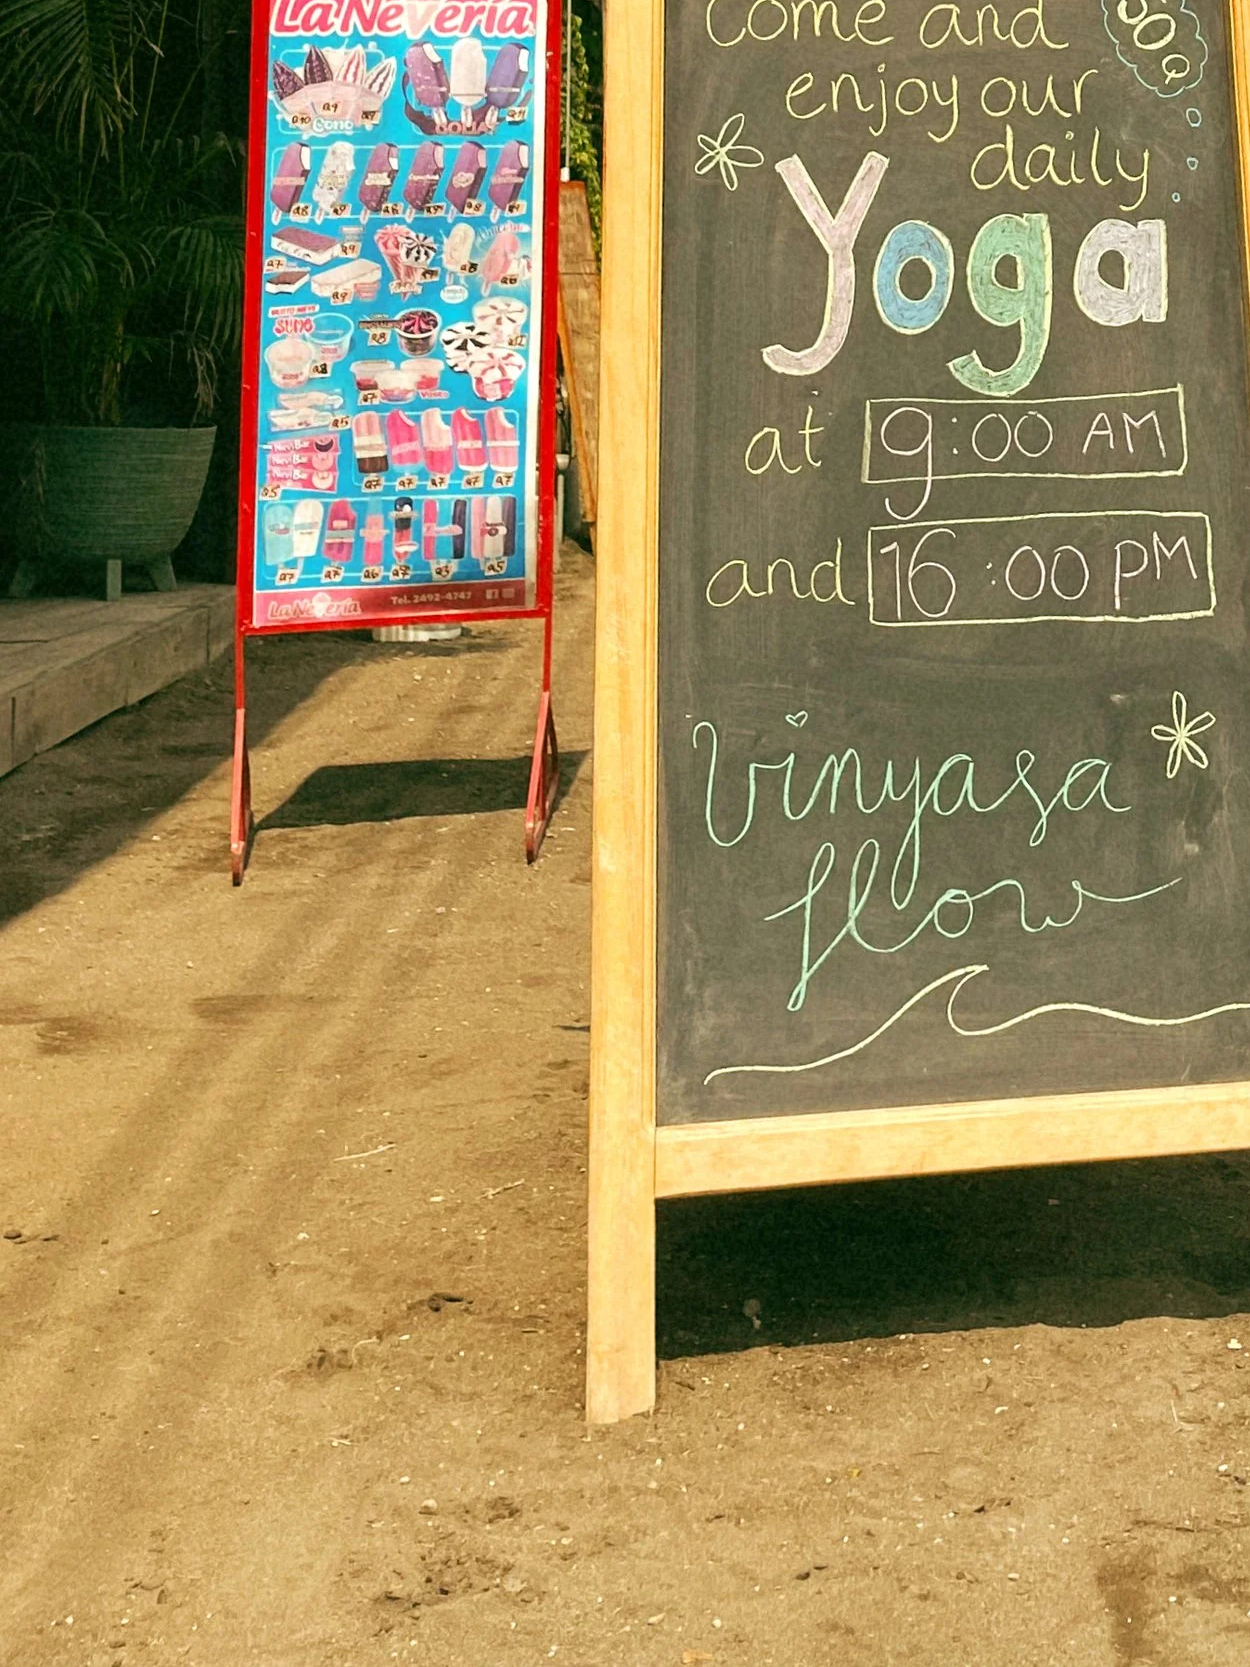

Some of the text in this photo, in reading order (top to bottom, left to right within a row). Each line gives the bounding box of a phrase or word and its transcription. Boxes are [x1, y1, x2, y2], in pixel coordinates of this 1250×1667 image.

[786, 63, 1099, 142] enjoy our
[970, 124, 1150, 211] daily
[761, 151, 1169, 397] Yoga
[745, 406, 824, 475] at
[1083, 410, 1166, 457] AM
[706, 537, 855, 607] and
[1115, 531, 1198, 609] PM
